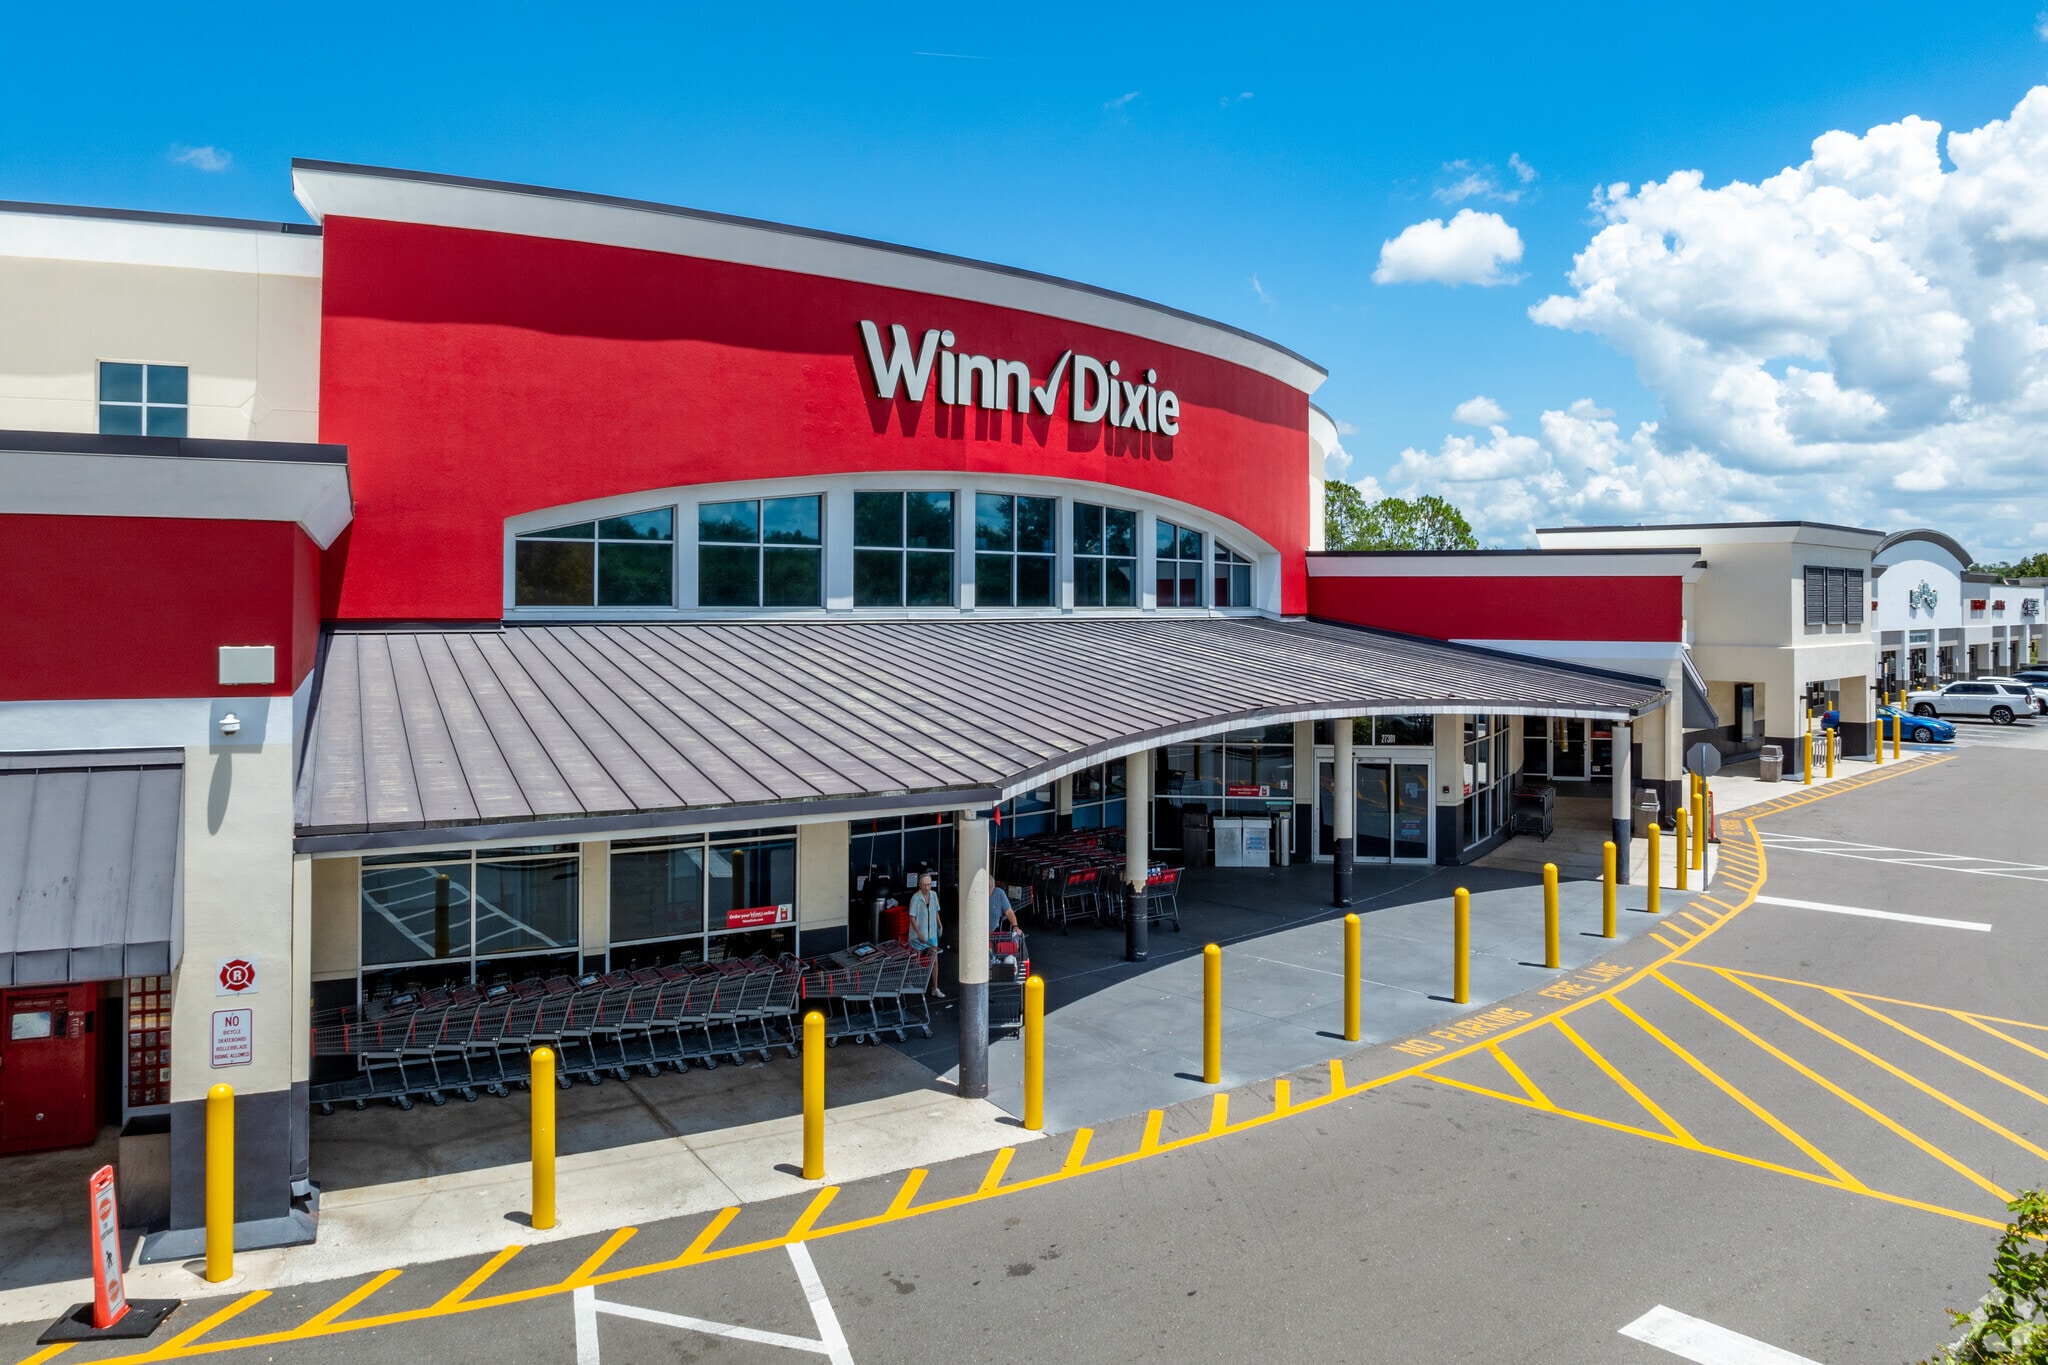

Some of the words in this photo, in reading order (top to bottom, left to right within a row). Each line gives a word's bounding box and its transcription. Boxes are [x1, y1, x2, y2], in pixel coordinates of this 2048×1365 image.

[858, 319, 1030, 414] Winn
[1069, 353, 1180, 436] Dixie
[233, 970, 242, 981] R
[1391, 1038, 1446, 1058] NO
[1429, 1007, 1534, 1043] PARKING
[1538, 980, 1597, 1001] FIRE
[1574, 961, 1634, 983] LANE
[225, 1016, 239, 1027] NO
[218, 1036, 246, 1044] SKATEBOARD
